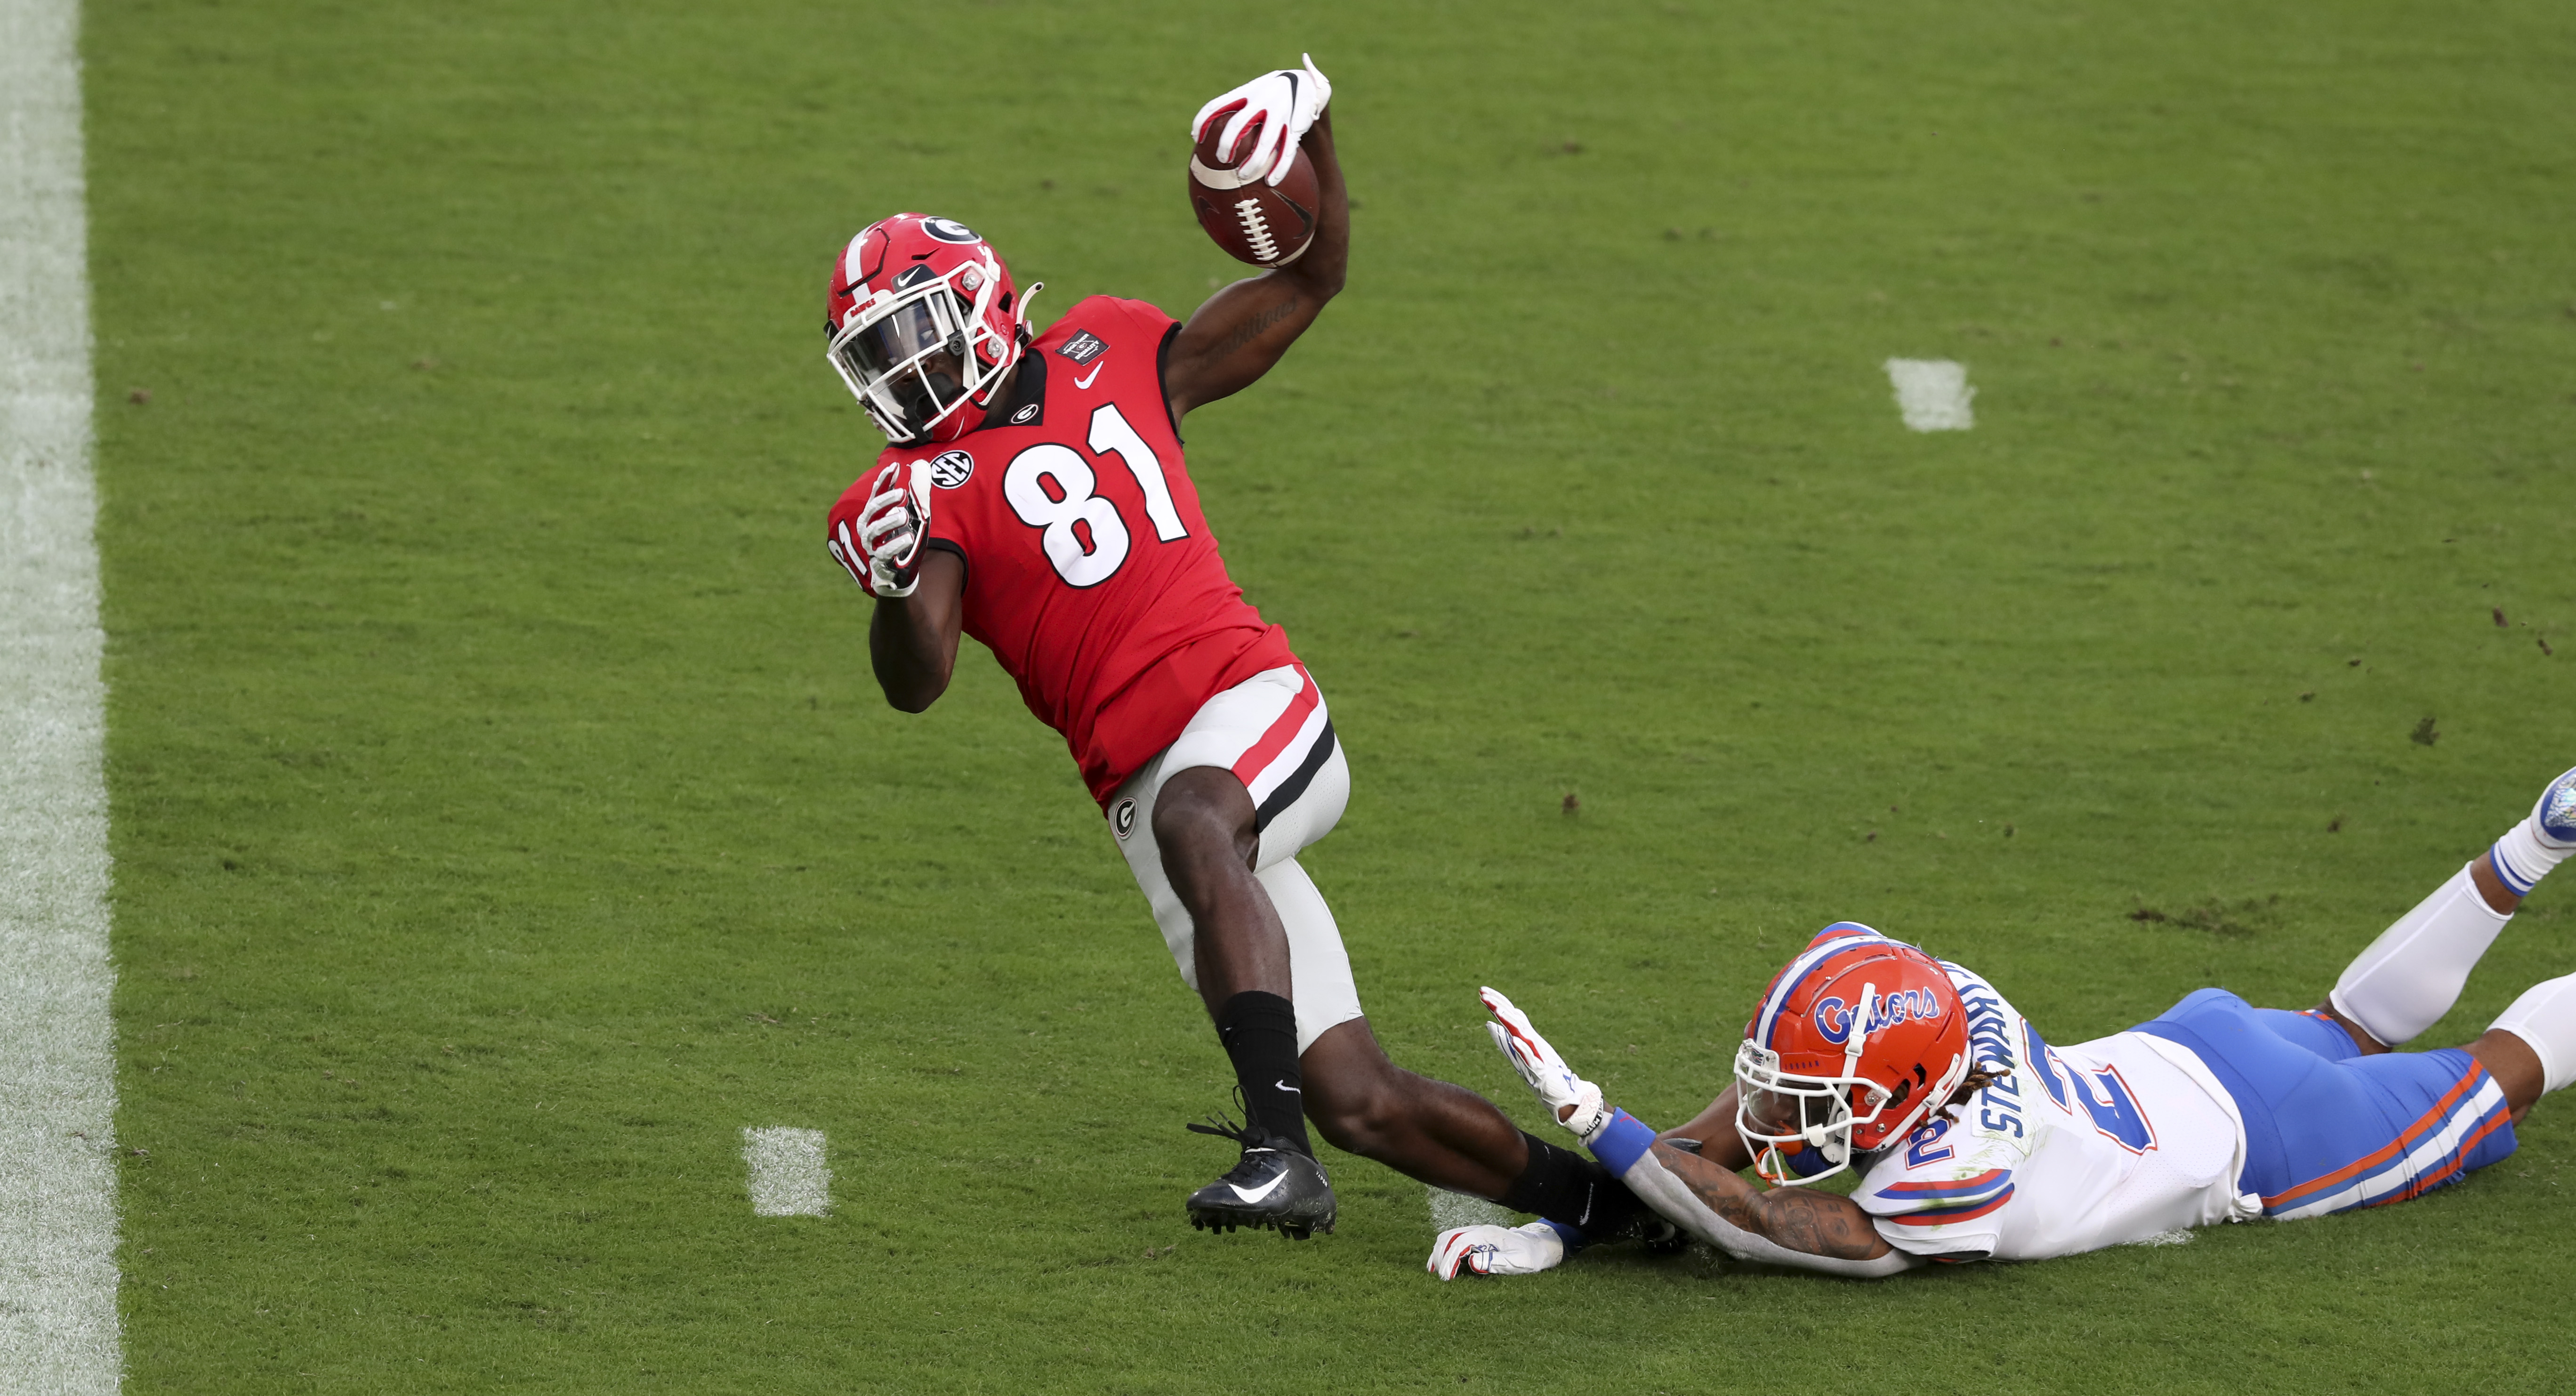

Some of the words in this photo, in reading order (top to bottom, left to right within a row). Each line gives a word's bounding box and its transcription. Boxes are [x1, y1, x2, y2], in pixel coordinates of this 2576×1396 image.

[1063, 333, 1090, 354] TOGETHER
[1074, 340, 1099, 360] EQUALITY
[932, 452, 971, 485] SEC
[1002, 401, 1191, 589] 81
[2021, 1016, 2157, 1156] 2
[1905, 1118, 1955, 1170] 2
[1316, 1170, 1328, 1187] VAPOR
